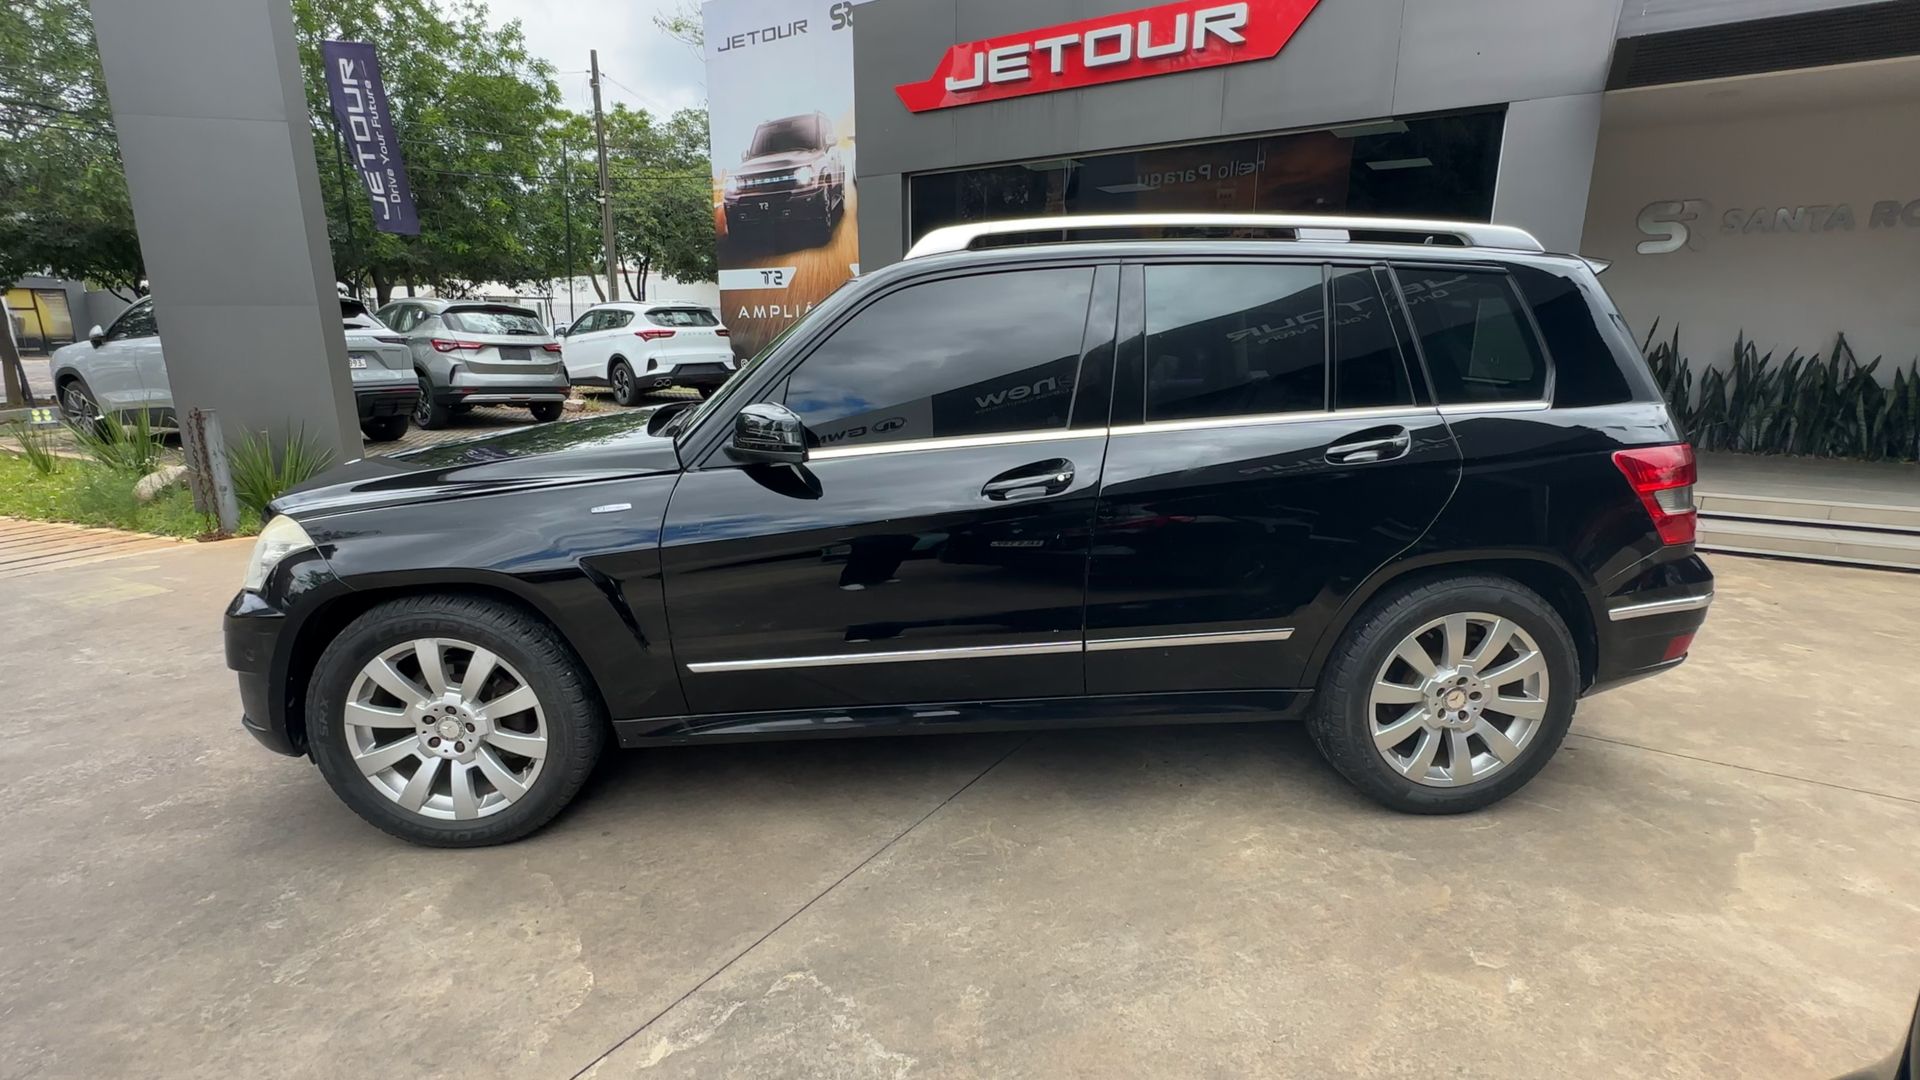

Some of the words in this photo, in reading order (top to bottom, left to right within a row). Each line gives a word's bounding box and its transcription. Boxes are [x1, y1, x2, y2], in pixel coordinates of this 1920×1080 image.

[717, 19, 808, 52] JETOUR
[944, 2, 1249, 92] JETOUR
[364, 80, 382, 128] Future
[338, 58, 390, 220] JETOUR
[375, 130, 391, 165] Your
[386, 168, 401, 204] Drive
[1720, 204, 1855, 234] SANTA
[760, 270, 783, 285] T2
[319, 696, 329, 737] SRX
